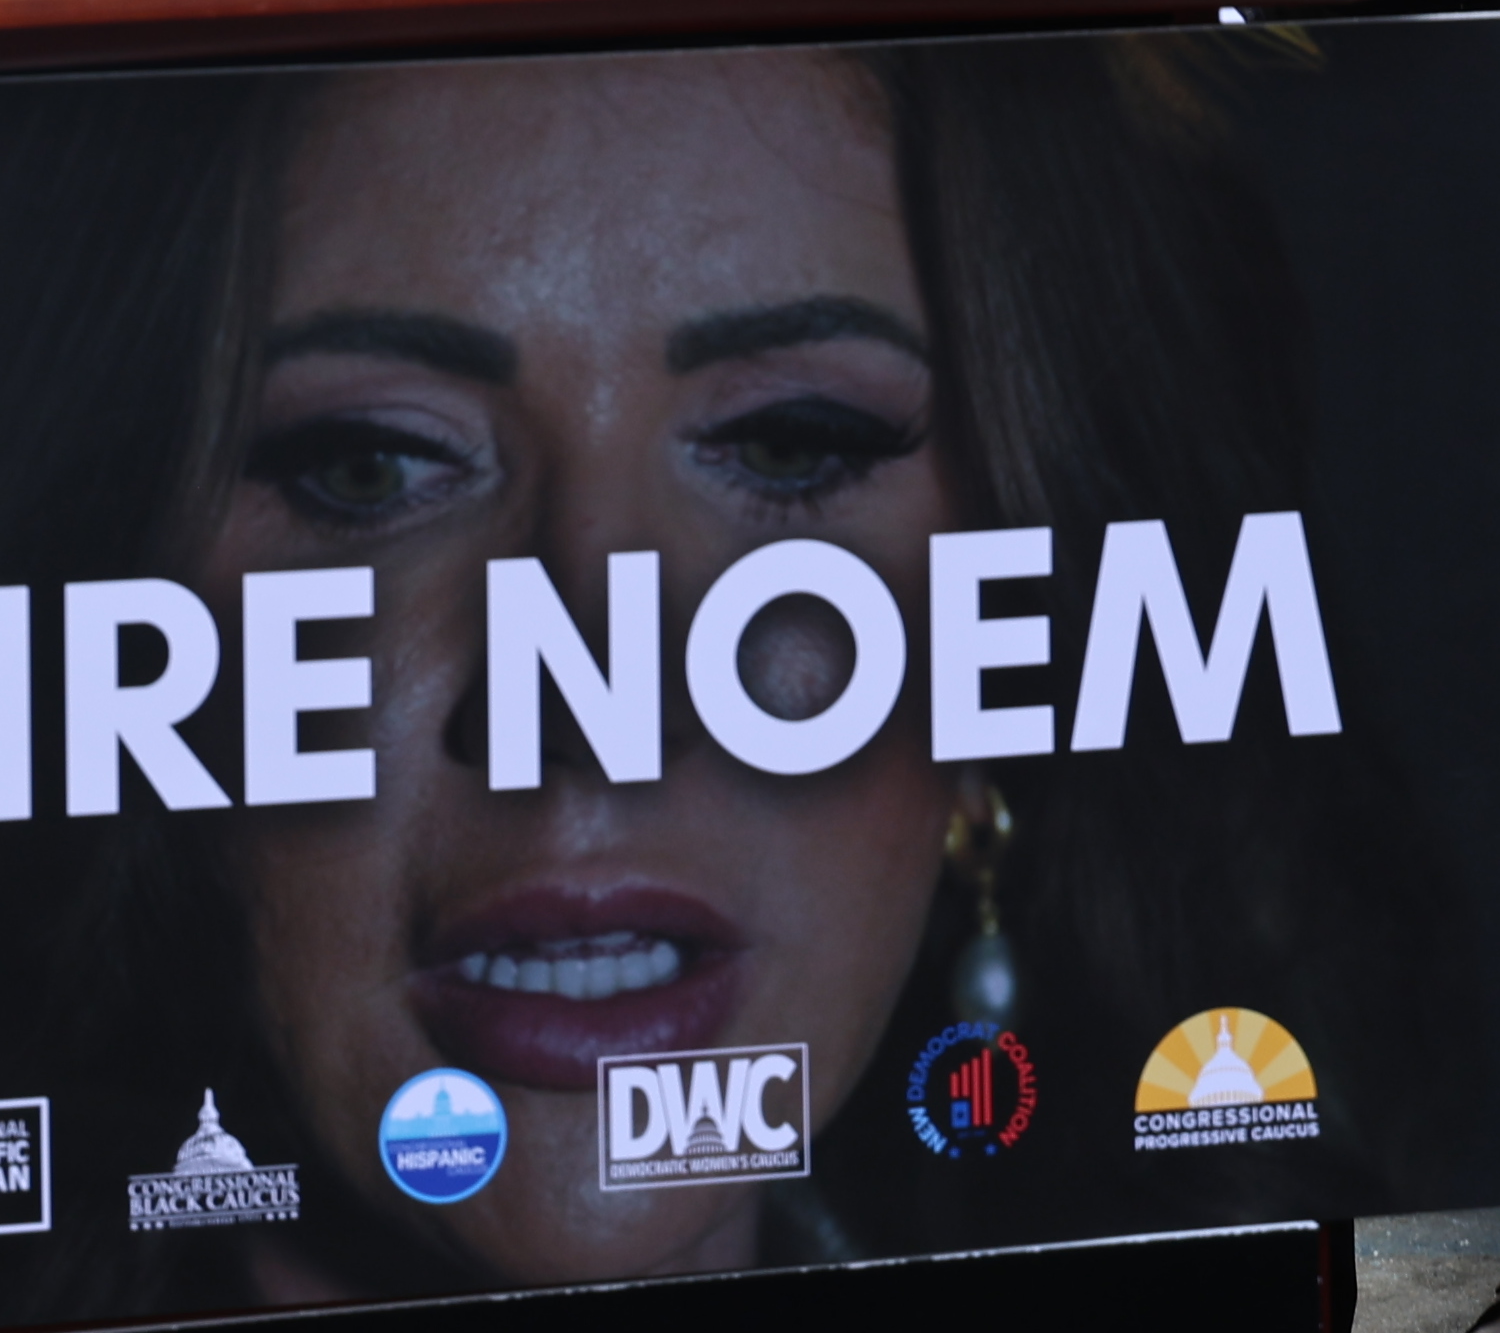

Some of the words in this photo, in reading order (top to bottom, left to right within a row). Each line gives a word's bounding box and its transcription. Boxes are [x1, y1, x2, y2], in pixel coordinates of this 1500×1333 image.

[485, 510, 1343, 793] NOEM
[907, 1021, 999, 1102] DEMOCRAT
[608, 1053, 799, 1161] DWC
[998, 1030, 1038, 1148] COALITION
[908, 1106, 948, 1154] NEW
[1133, 1101, 1318, 1134] CONGRESSIONAL
[1134, 1125, 1248, 1152] PROGRESSIVE
[1250, 1121, 1320, 1142] CAUCUS
[396, 1145, 487, 1171] HISPANIC
[128, 1170, 298, 1198] CONGRESSIONAL
[130, 1193, 203, 1217] BLACK
[205, 1186, 301, 1211] CAUCUS
